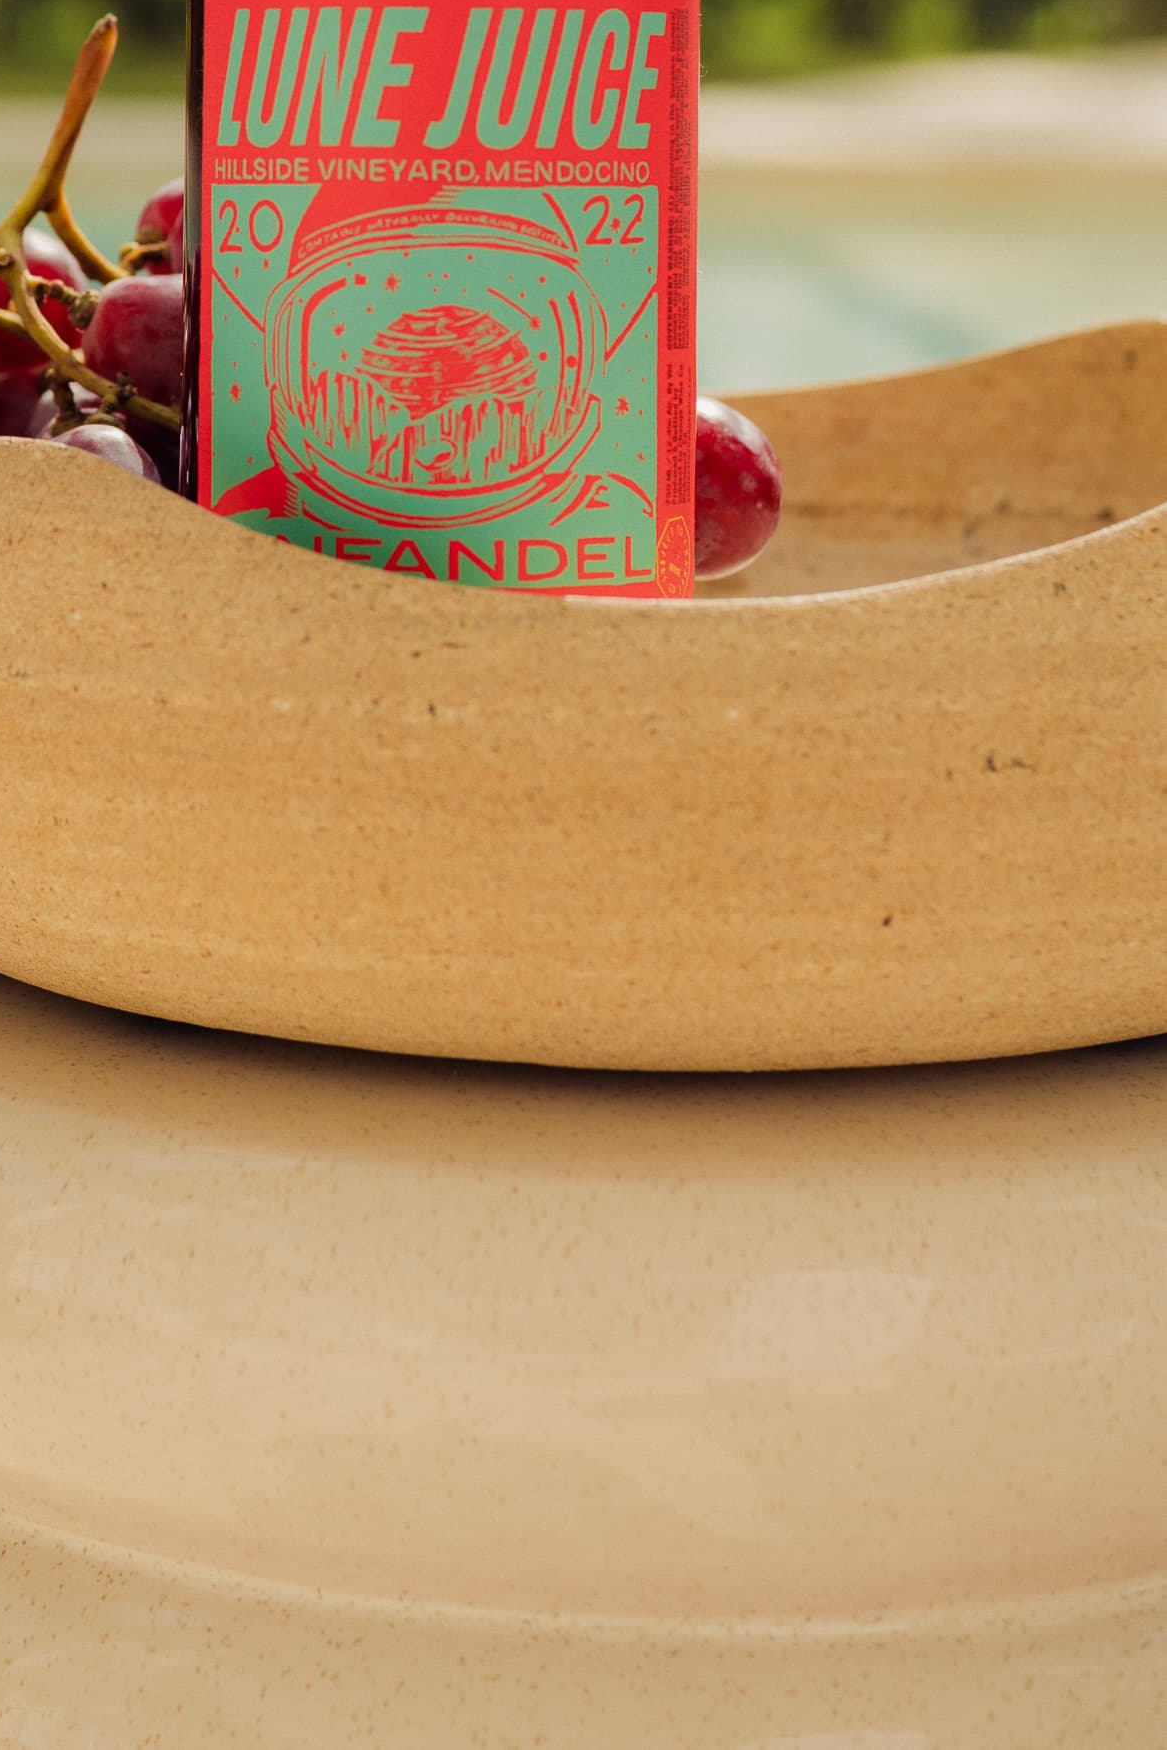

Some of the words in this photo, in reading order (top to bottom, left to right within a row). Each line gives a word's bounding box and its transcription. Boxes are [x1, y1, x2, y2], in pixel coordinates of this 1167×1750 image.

[217, 6, 430, 149] LUNE
[423, 7, 667, 151] JUICE
[214, 157, 310, 182] HILLSIDE
[318, 158, 481, 184] VINEYARD,
[485, 160, 651, 184] MENDOCINO
[218, 199, 285, 254] 20
[582, 193, 645, 246] 22
[275, 534, 653, 582] FANDEL
